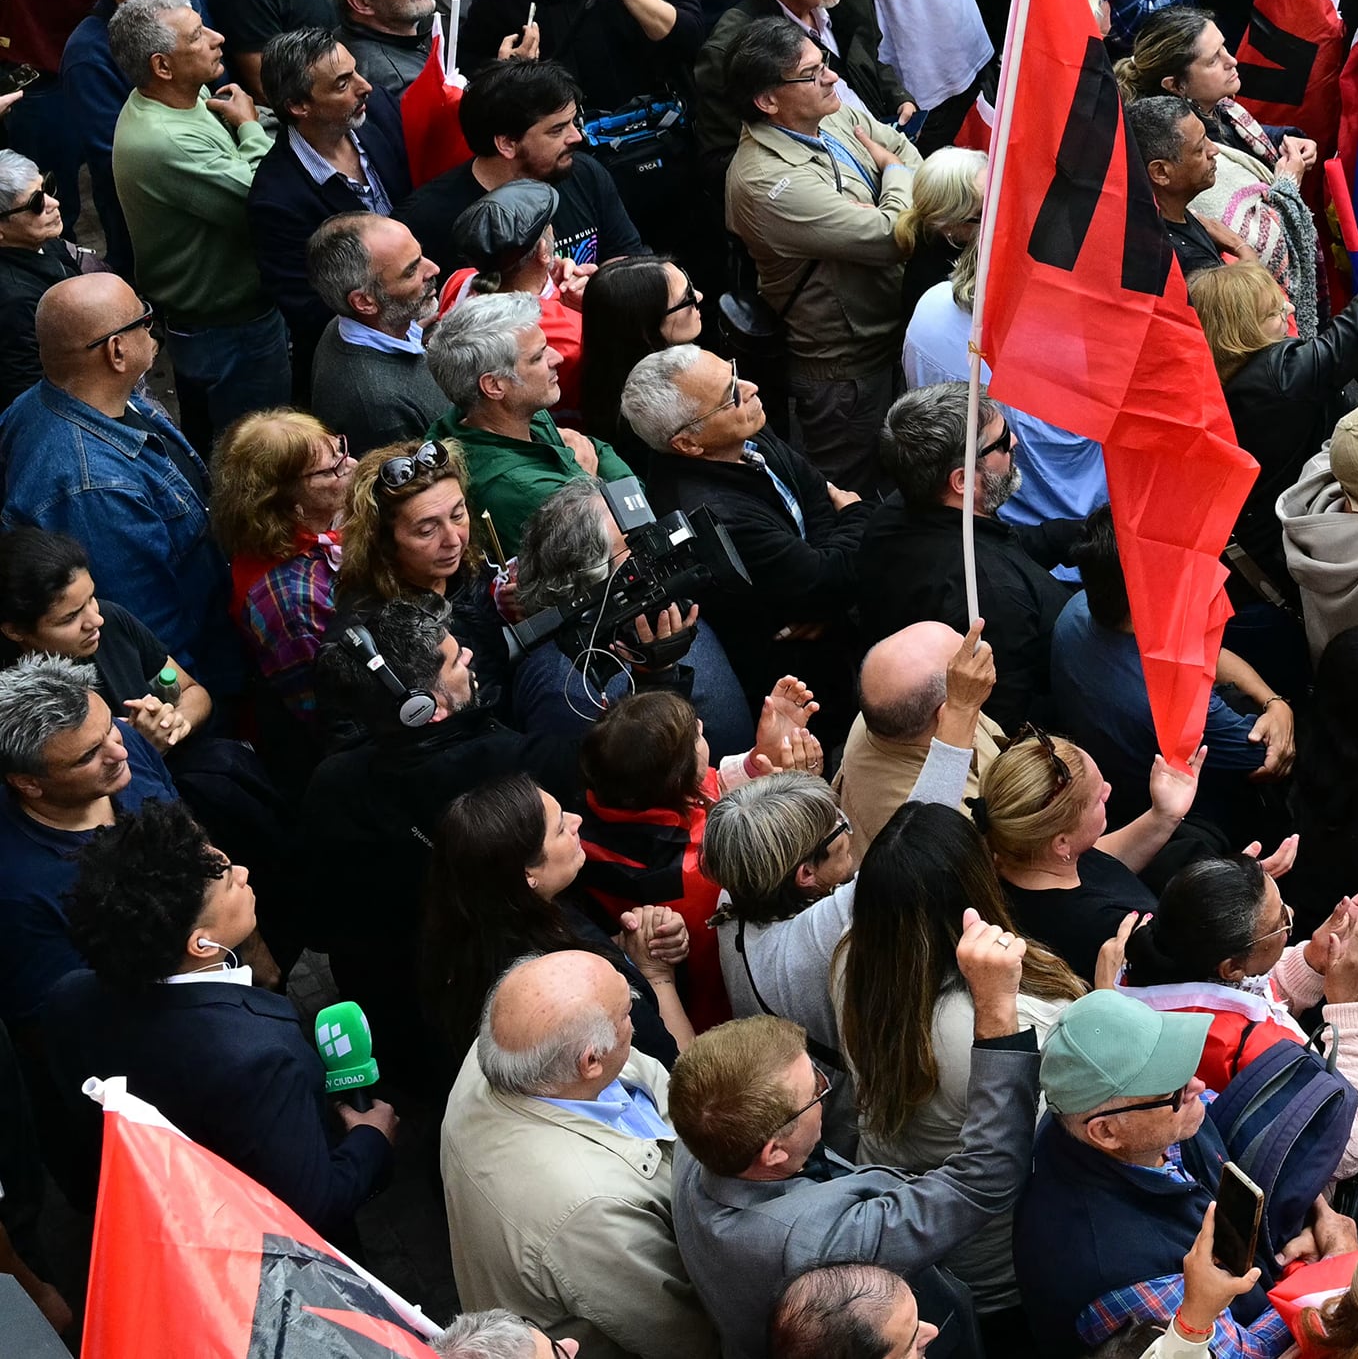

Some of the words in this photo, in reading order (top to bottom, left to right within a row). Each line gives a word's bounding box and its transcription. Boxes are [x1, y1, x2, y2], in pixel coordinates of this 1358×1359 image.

[554, 236, 573, 248] STRA
[410, 825, 435, 850] sonic
[333, 1074, 365, 1087] CIUDAD
